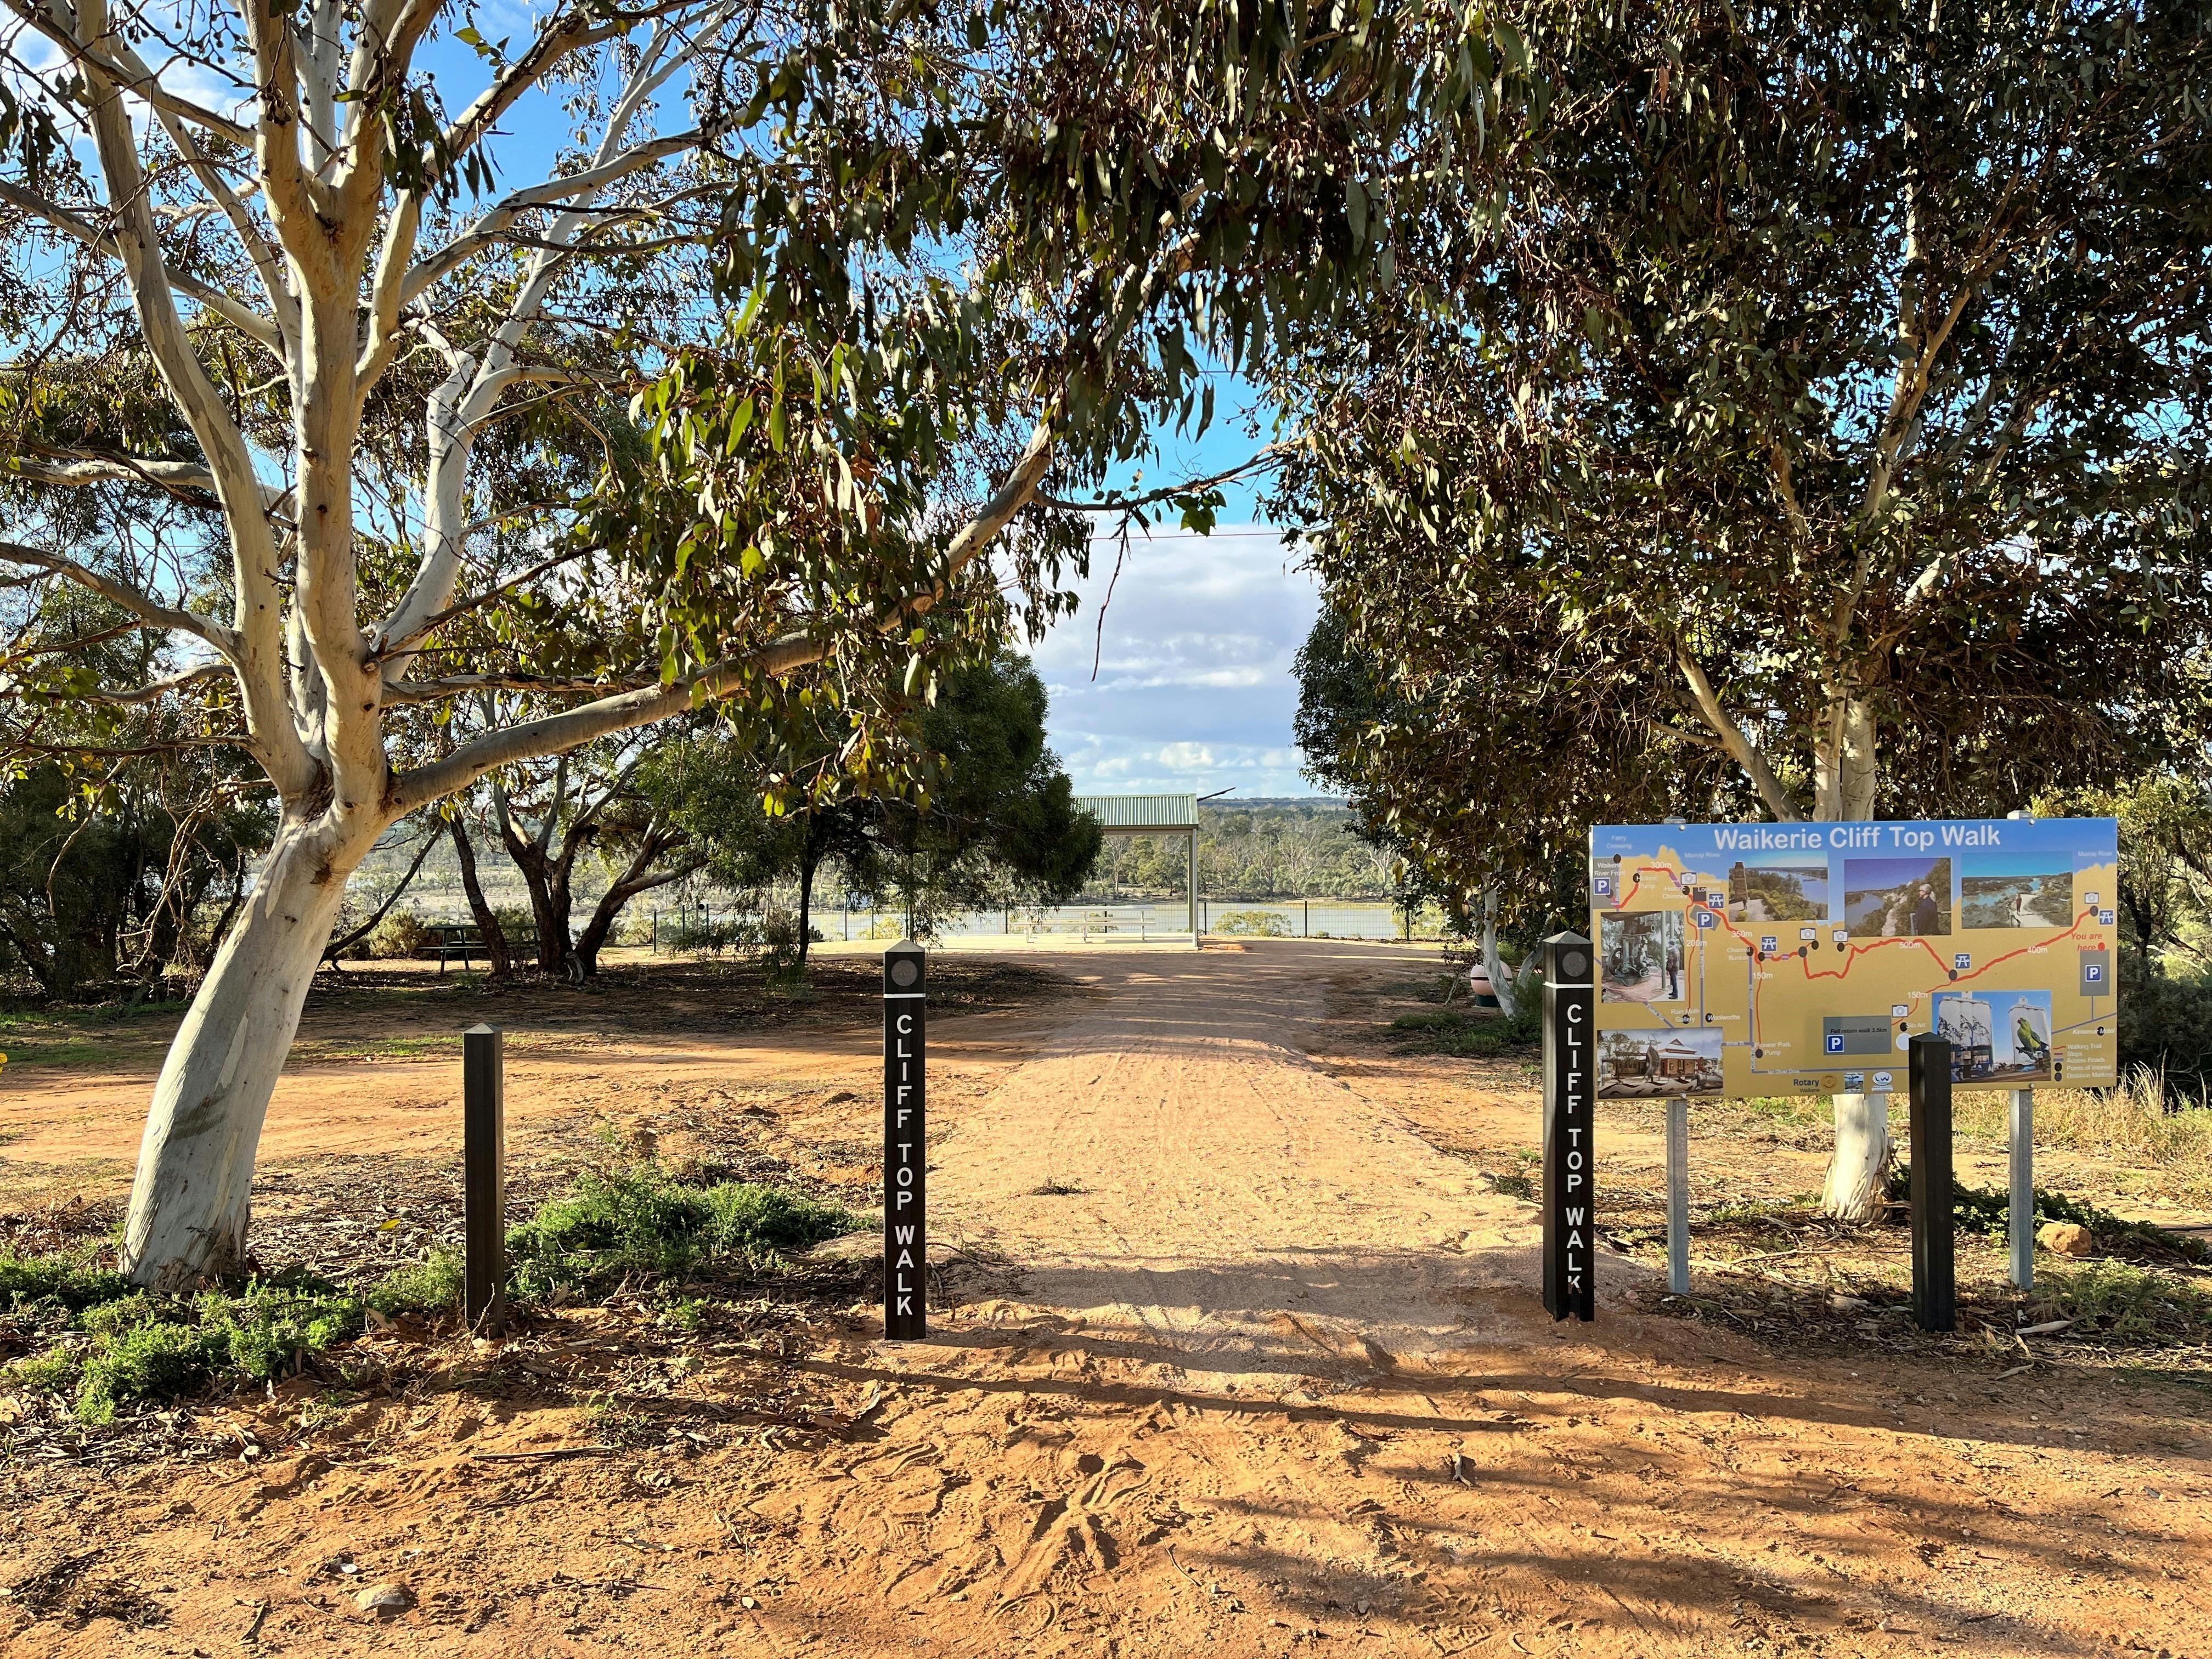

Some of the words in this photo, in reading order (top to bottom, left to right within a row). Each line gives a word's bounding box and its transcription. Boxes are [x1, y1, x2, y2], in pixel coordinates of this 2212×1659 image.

[1713, 827, 1822, 850] Waikerie
[1830, 826, 1880, 849] Cliff
[1889, 826, 1934, 851] Top
[1941, 825, 2001, 847] Walk
[895, 1014, 914, 1129] CLIFF
[1567, 1003, 1583, 1114] CLIFF
[1793, 1079, 1820, 1087] Rotary
[896, 1143, 914, 1211] TOP
[1567, 1128, 1583, 1194] TOP
[895, 1224, 915, 1316] WALK
[1565, 1207, 1585, 1295] WALK
